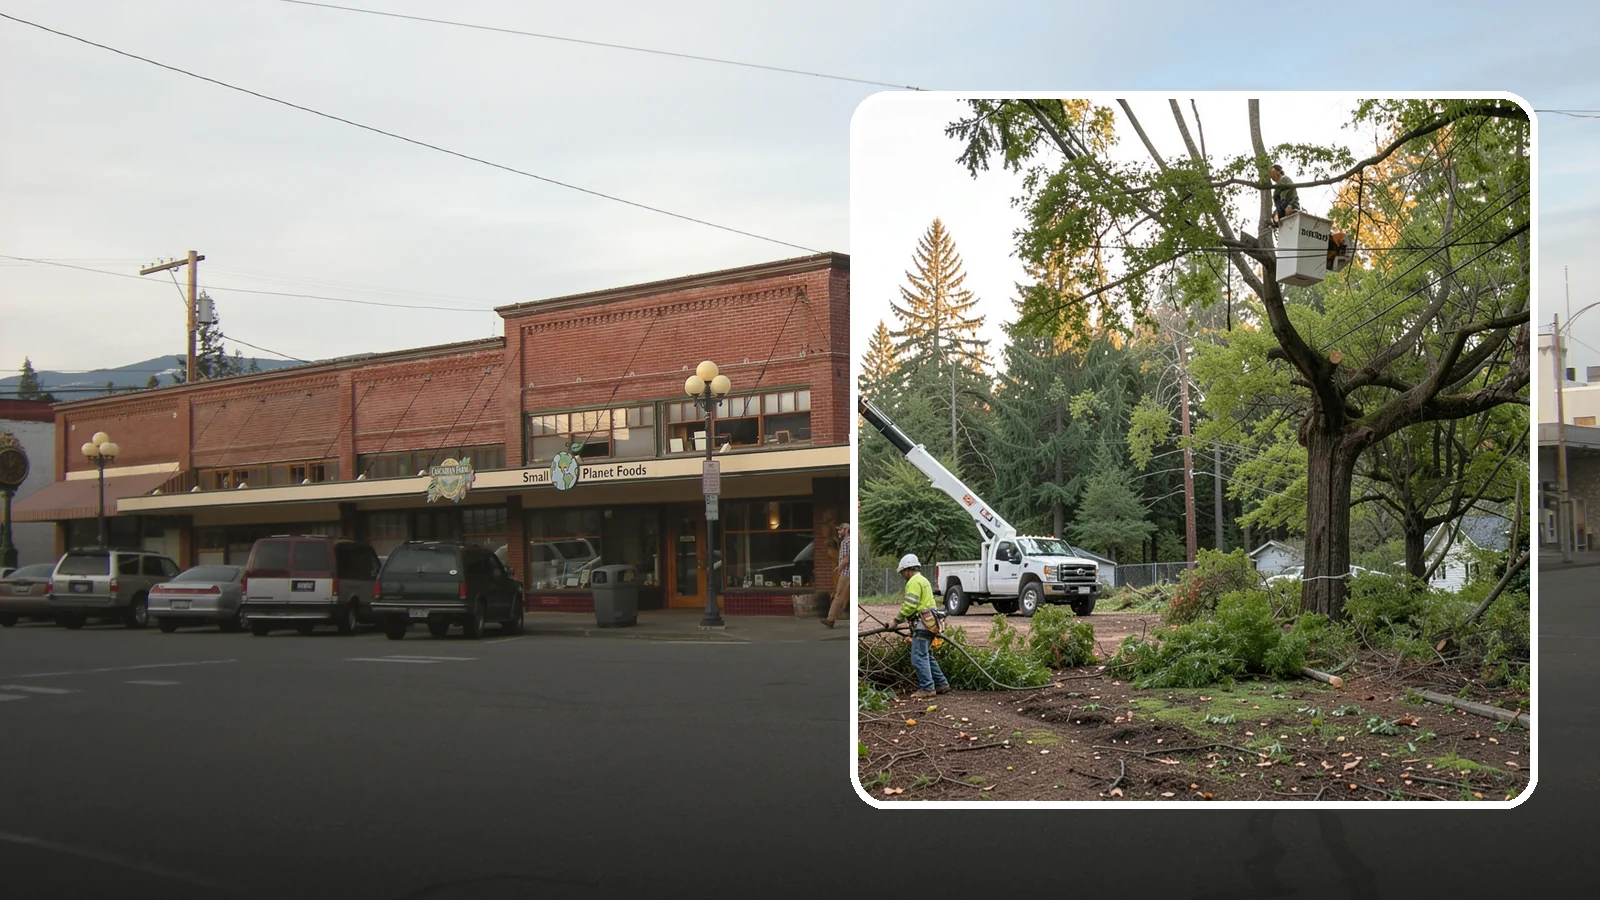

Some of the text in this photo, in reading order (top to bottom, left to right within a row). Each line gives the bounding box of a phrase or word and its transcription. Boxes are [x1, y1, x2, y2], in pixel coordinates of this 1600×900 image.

[523, 464, 647, 483] Small Planet Foods
